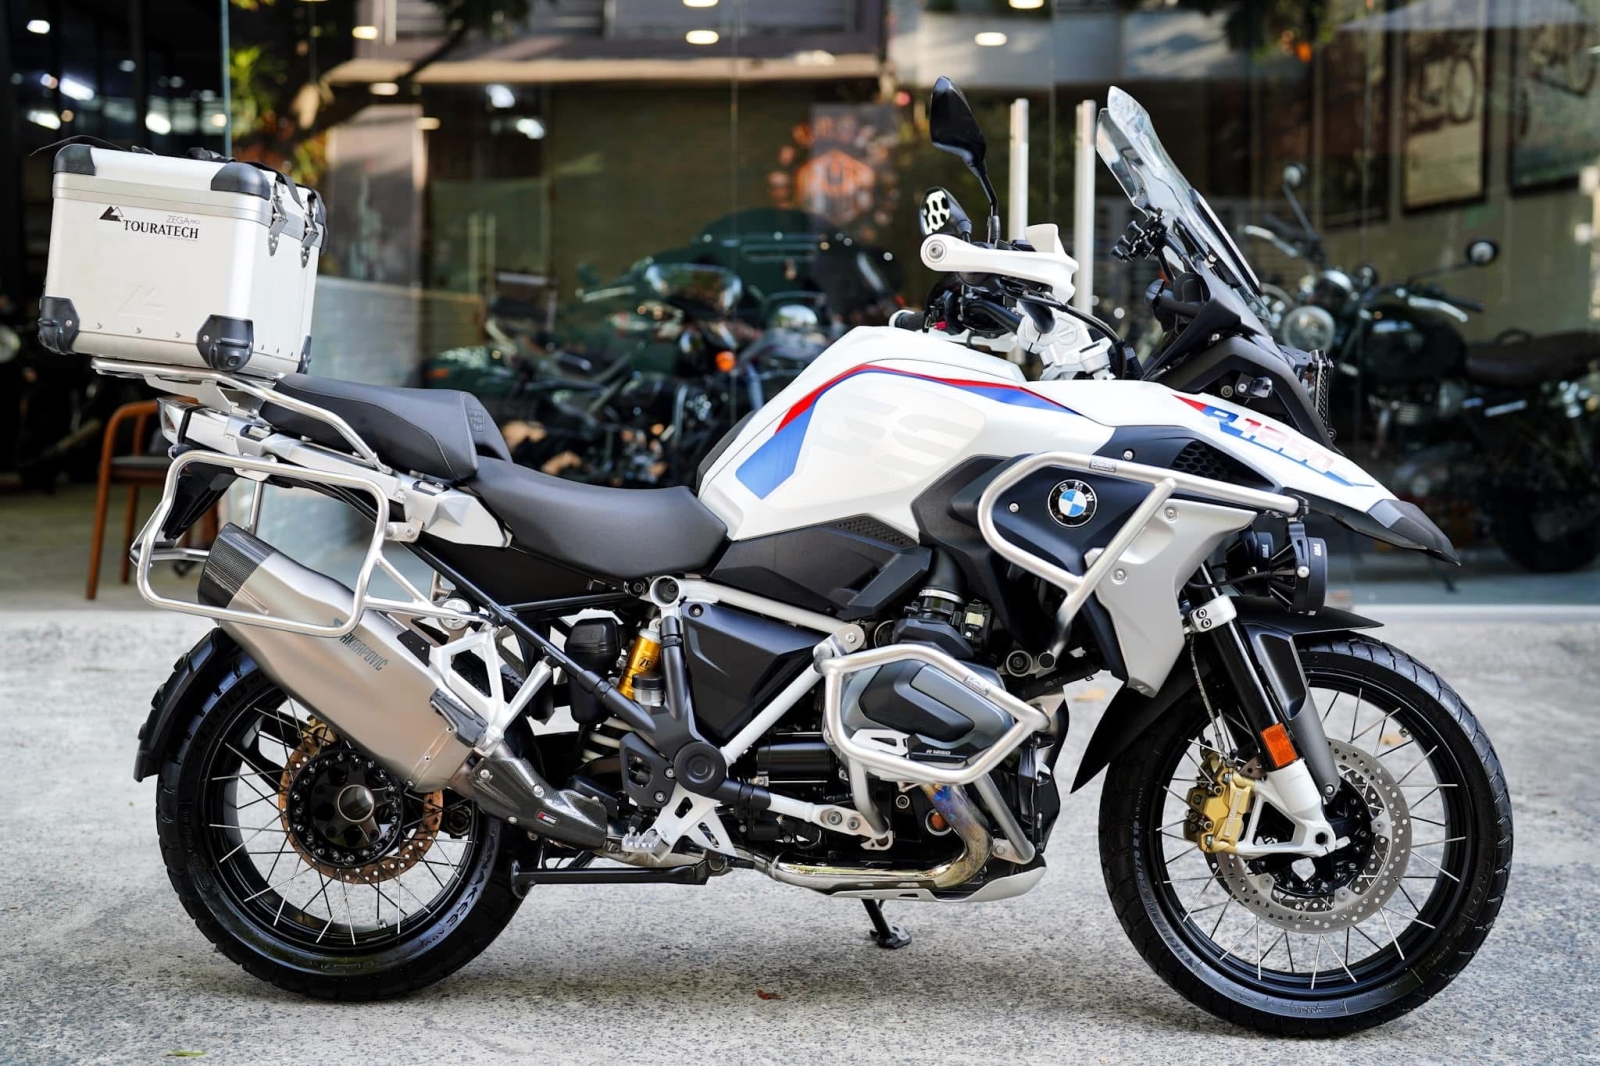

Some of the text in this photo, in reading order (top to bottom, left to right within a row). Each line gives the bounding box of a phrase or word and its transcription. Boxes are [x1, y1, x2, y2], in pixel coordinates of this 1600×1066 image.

[123, 219, 200, 239] TOURATECH
[166, 214, 190, 225] ZEGA
[1059, 481, 1095, 502] BMW
[1144, 898, 1192, 963] MICHELIN
